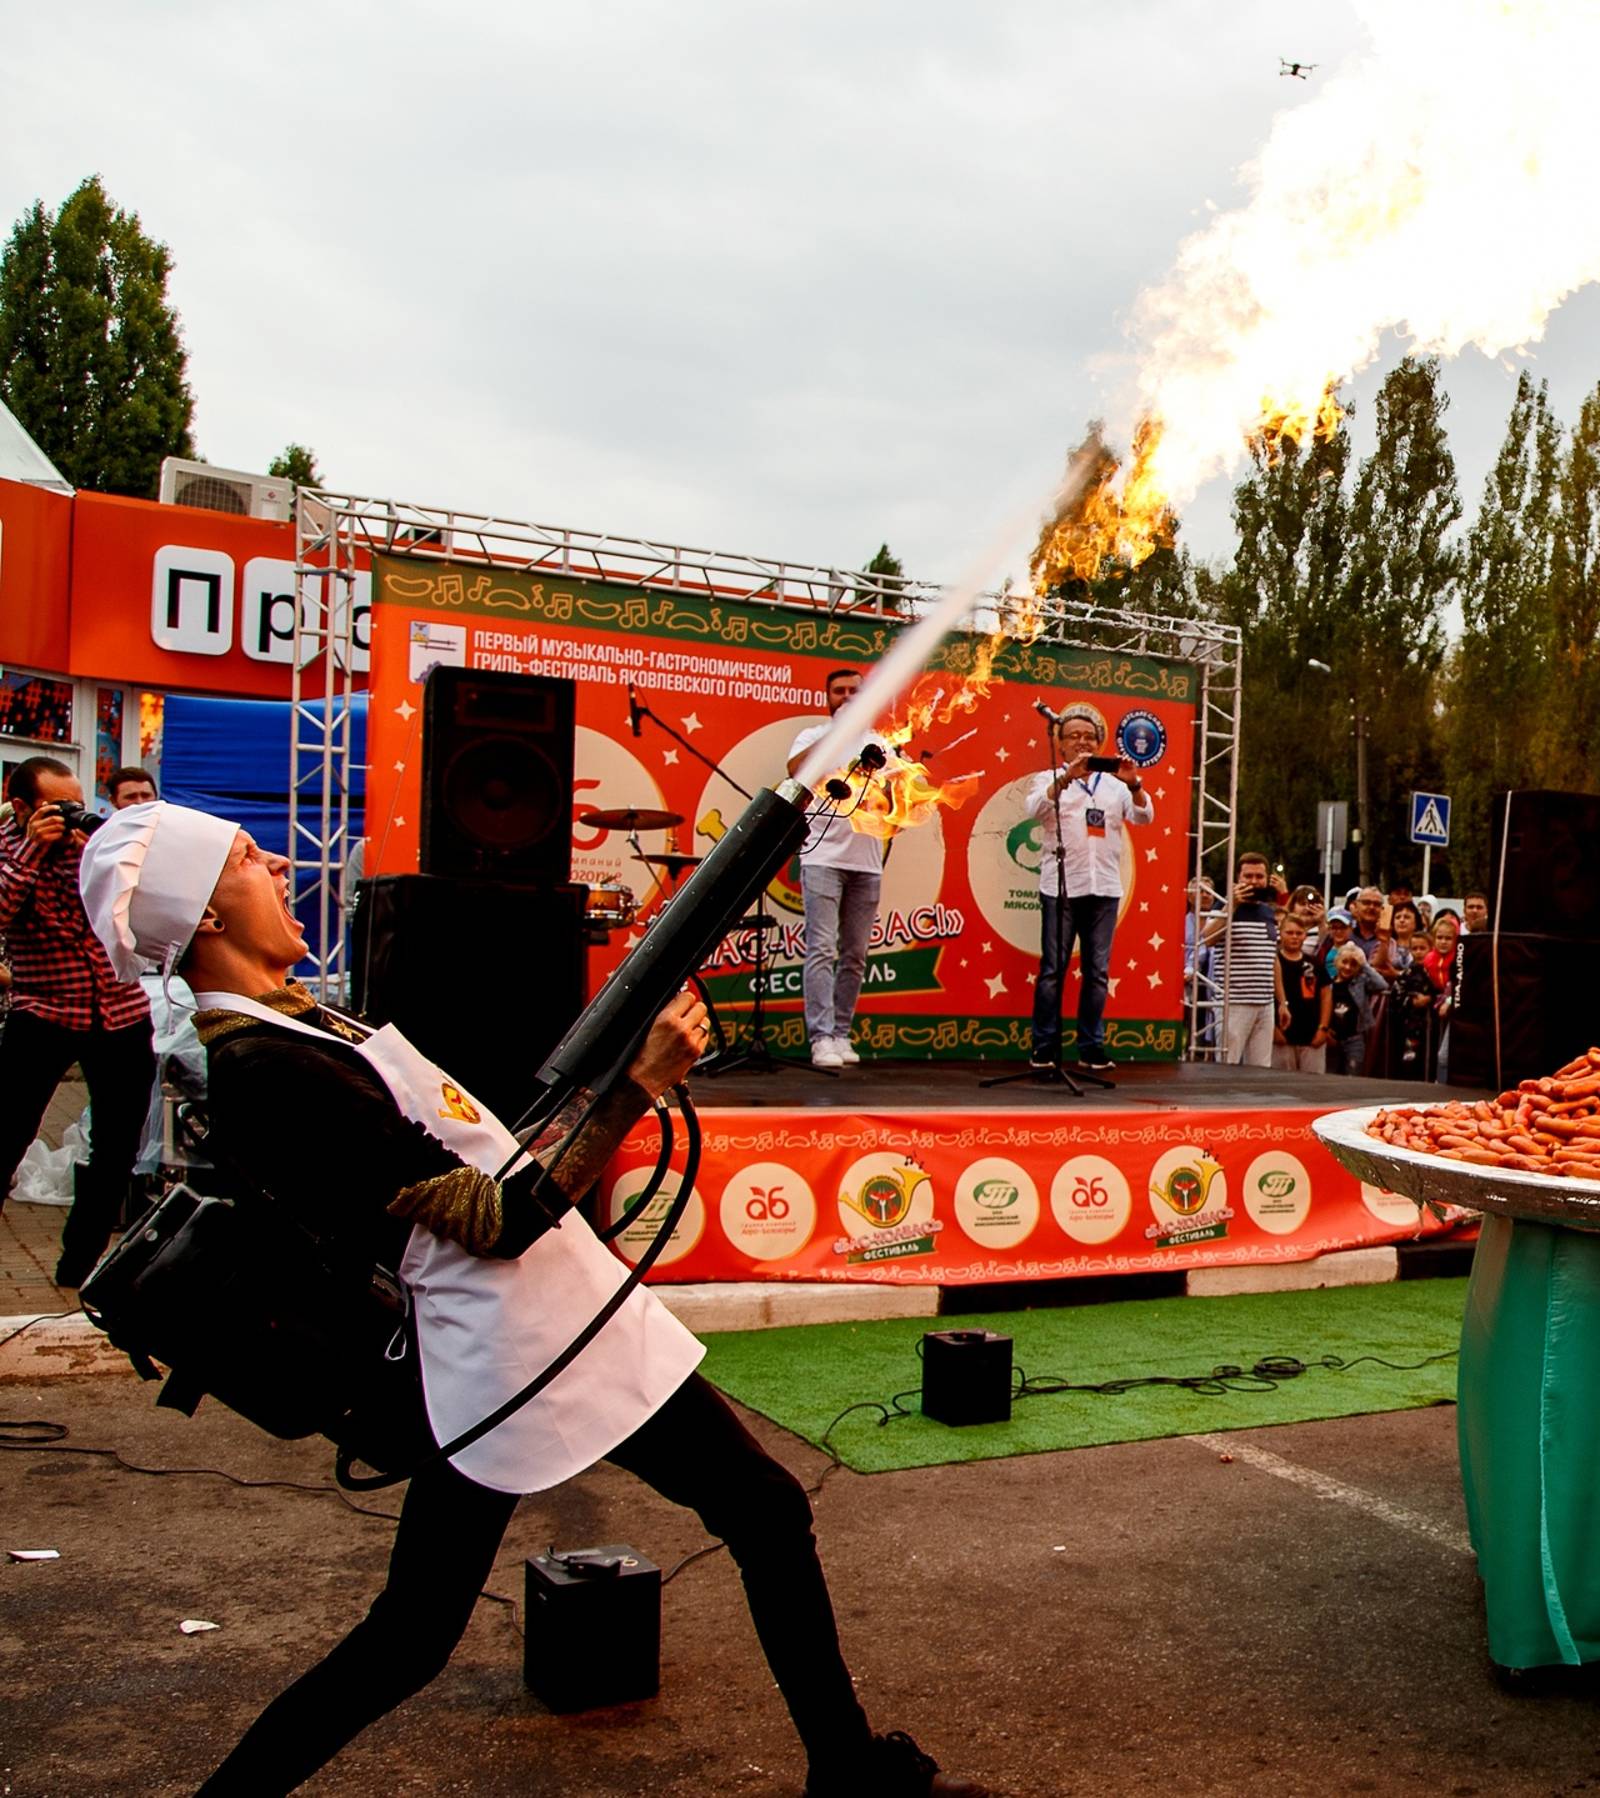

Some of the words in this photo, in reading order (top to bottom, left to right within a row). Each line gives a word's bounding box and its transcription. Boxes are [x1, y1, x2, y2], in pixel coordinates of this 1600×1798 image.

[474, 630, 539, 650] ПЕРВЫЙ
[542, 638, 792, 683] МУЗЫКАЛЬНО-ГАСТРОНОМИЧЕСКИЙ
[473, 652, 617, 684] ГРИЛЬ-ФЕСТИВАЛЬ
[619, 670, 726, 697] ЯКОВЛЕВСКОГО
[728, 681, 812, 707] ГОРОДСКОГО
[863, 1243, 919, 1260] ФЕСТИВАЛЬ
[1168, 1228, 1215, 1245] ФЕСТИВАЛЬ
